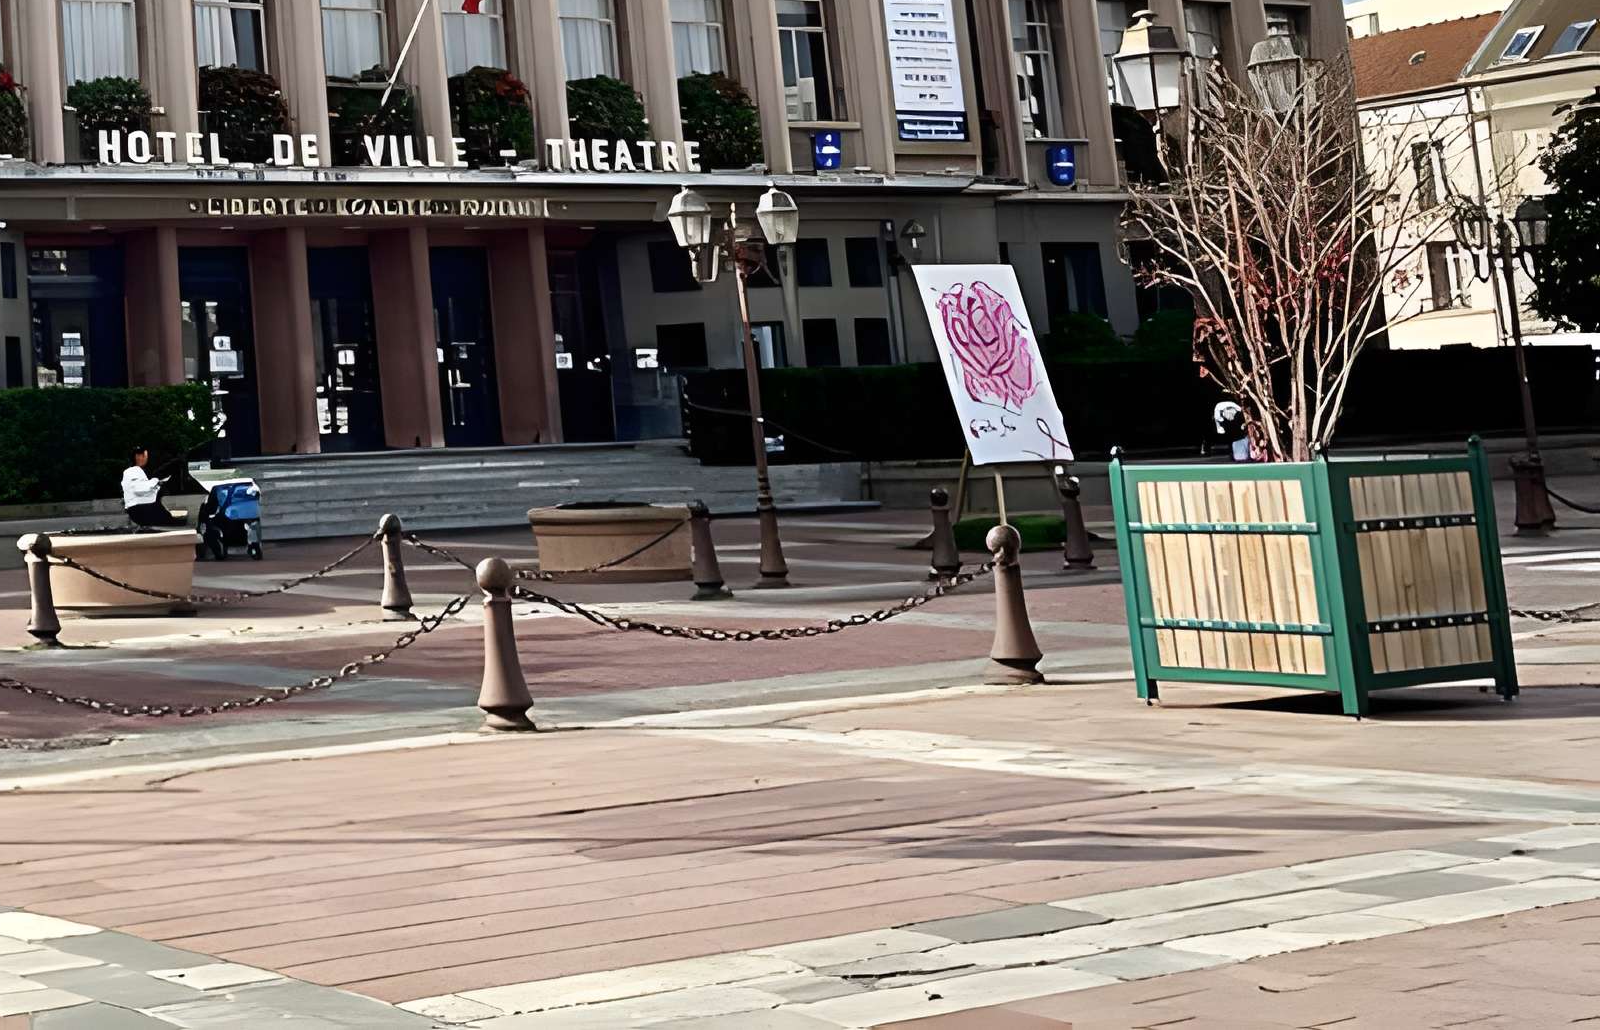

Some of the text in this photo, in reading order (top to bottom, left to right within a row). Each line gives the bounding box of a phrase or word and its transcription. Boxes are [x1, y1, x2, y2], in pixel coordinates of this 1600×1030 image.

[98, 129, 230, 165] HOTEL
[272, 134, 320, 167] DE
[363, 134, 469, 168] VILLE
[544, 137, 701, 171] THEATRE
